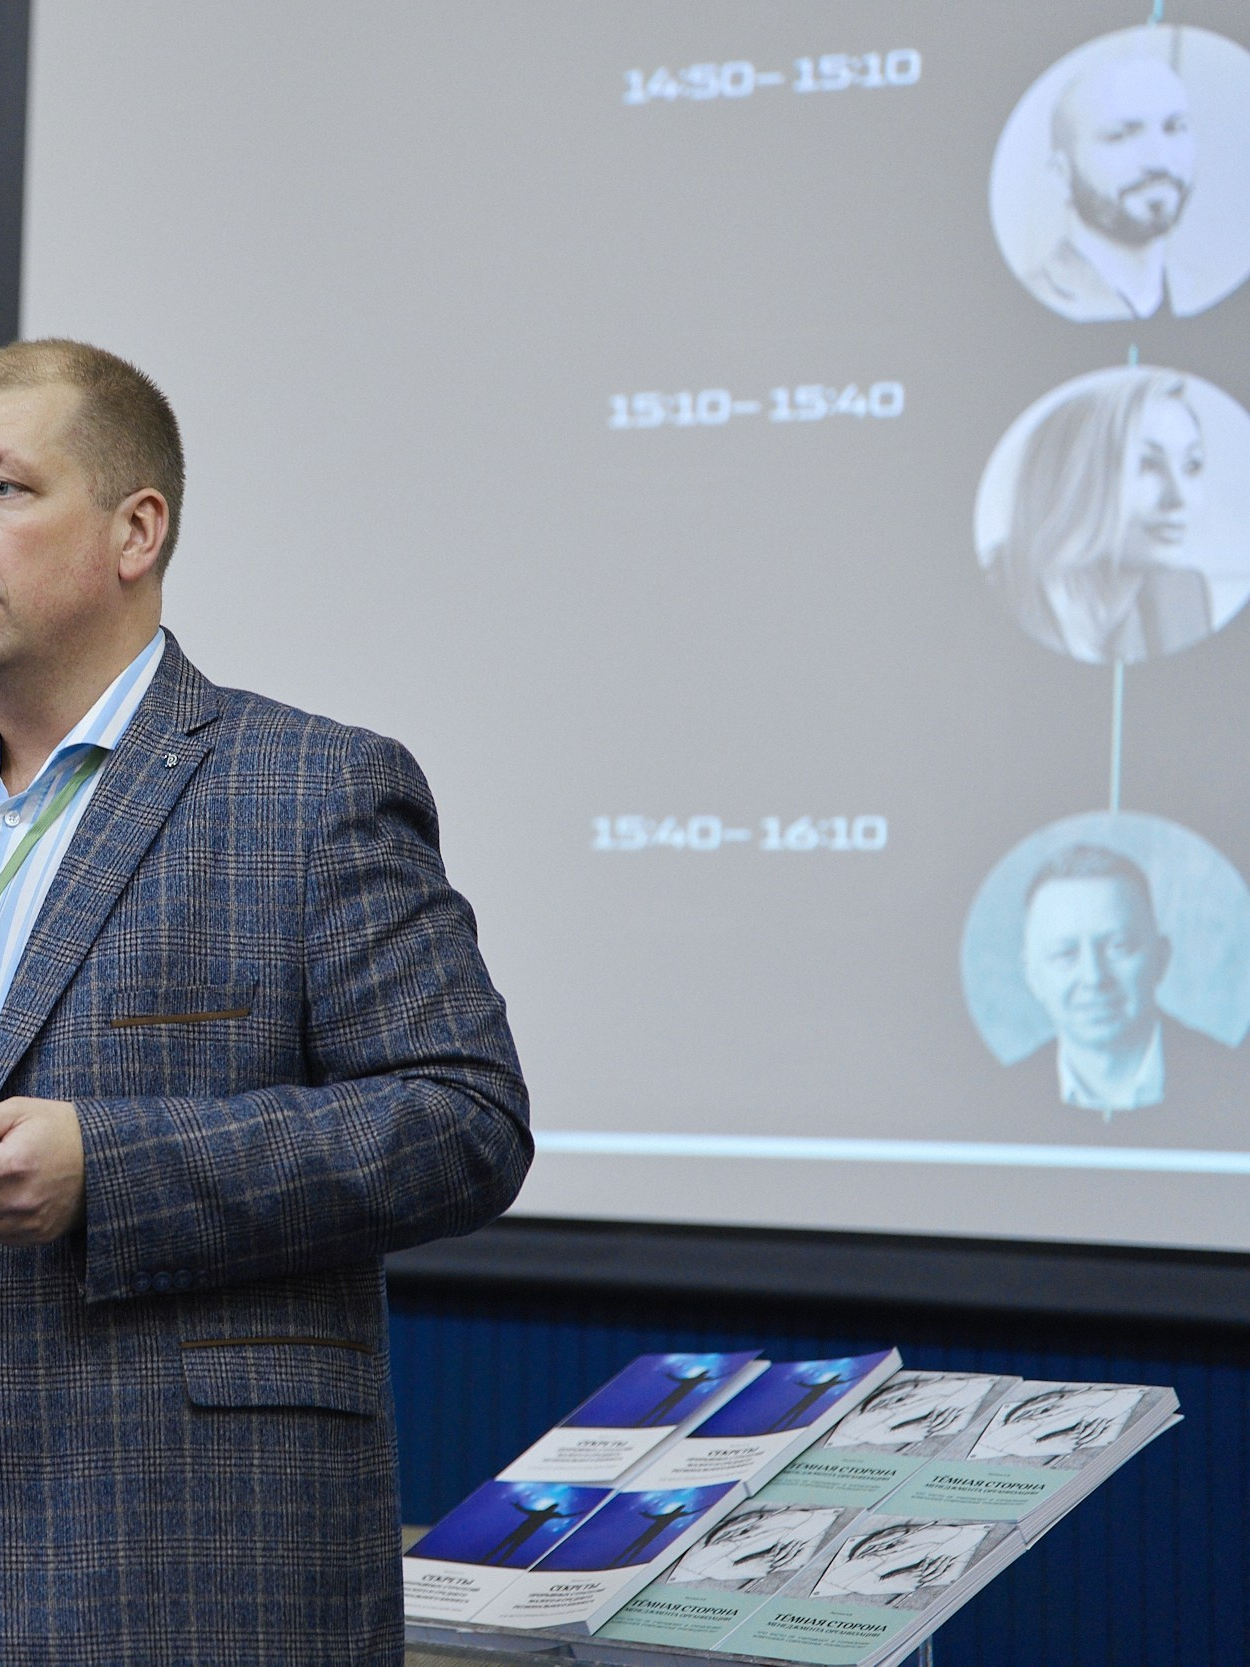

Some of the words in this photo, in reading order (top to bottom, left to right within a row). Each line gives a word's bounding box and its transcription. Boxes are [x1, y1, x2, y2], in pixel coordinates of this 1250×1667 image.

[794, 49, 921, 93] 15:10
[770, 381, 904, 424] 15:40
[761, 814, 887, 851] 16:10
[932, 1474, 985, 1487] ТЁМНАЯ
[985, 1480, 1046, 1490] СТОРОНА
[550, 1582, 602, 1591] СЕКРЕТЫ
[632, 1599, 682, 1611] ТЁМНАЯ
[681, 1605, 739, 1616] СТОРОНА
[775, 1613, 827, 1627] ТЁМНАЯ
[827, 1620, 888, 1632] СТОРОНА
